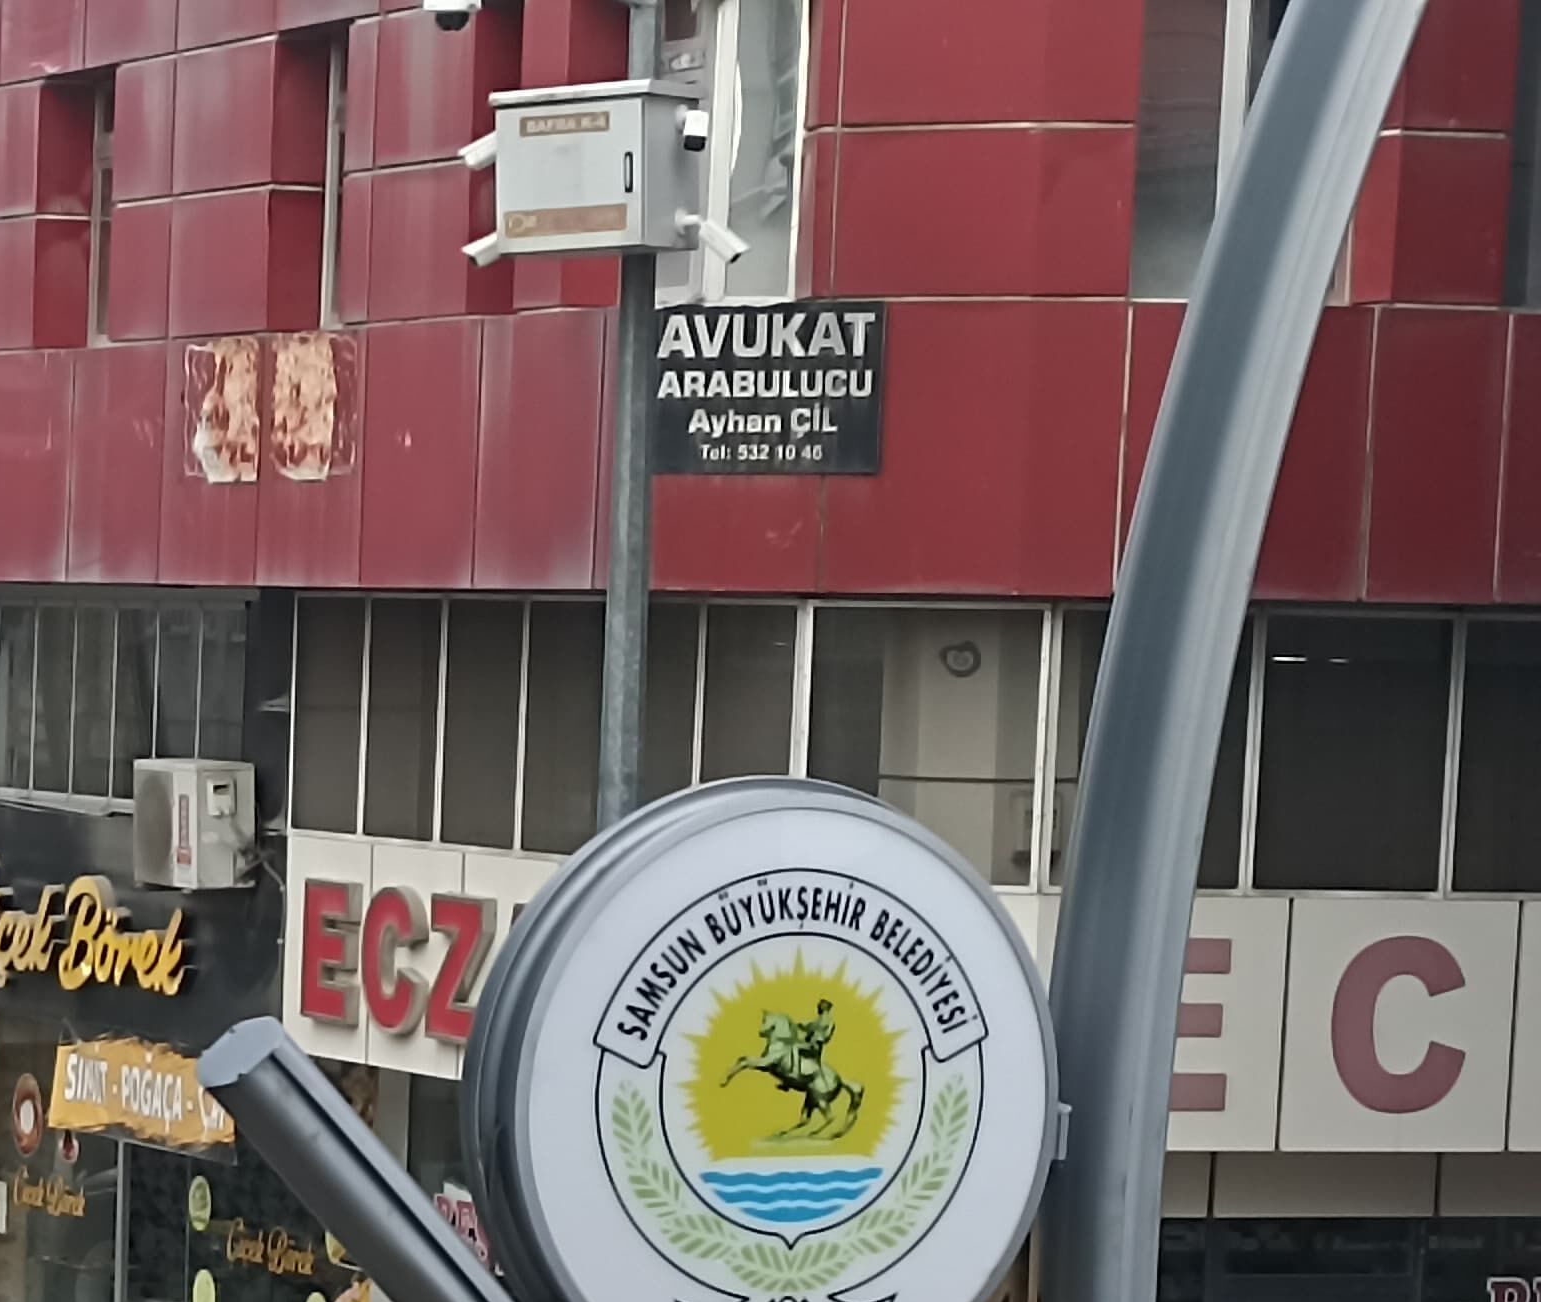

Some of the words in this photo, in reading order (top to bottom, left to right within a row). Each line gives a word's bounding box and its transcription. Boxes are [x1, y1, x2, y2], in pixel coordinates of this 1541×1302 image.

[657, 312, 876, 358] AVUKAT
[657, 369, 873, 398] ARABULUCU
[688, 408, 782, 438] Ayhan
[790, 402, 838, 438] ÇİL
[700, 443, 732, 460] Tel:
[737, 443, 769, 460] 532
[776, 443, 796, 460] 10
[57, 875, 186, 996] Börek
[300, 877, 525, 1043] ECZ
[617, 929, 708, 1041] SAMSUN
[703, 878, 867, 945] BÜYÜKŞEHİR
[869, 908, 979, 1034] BELEDİYESİ
